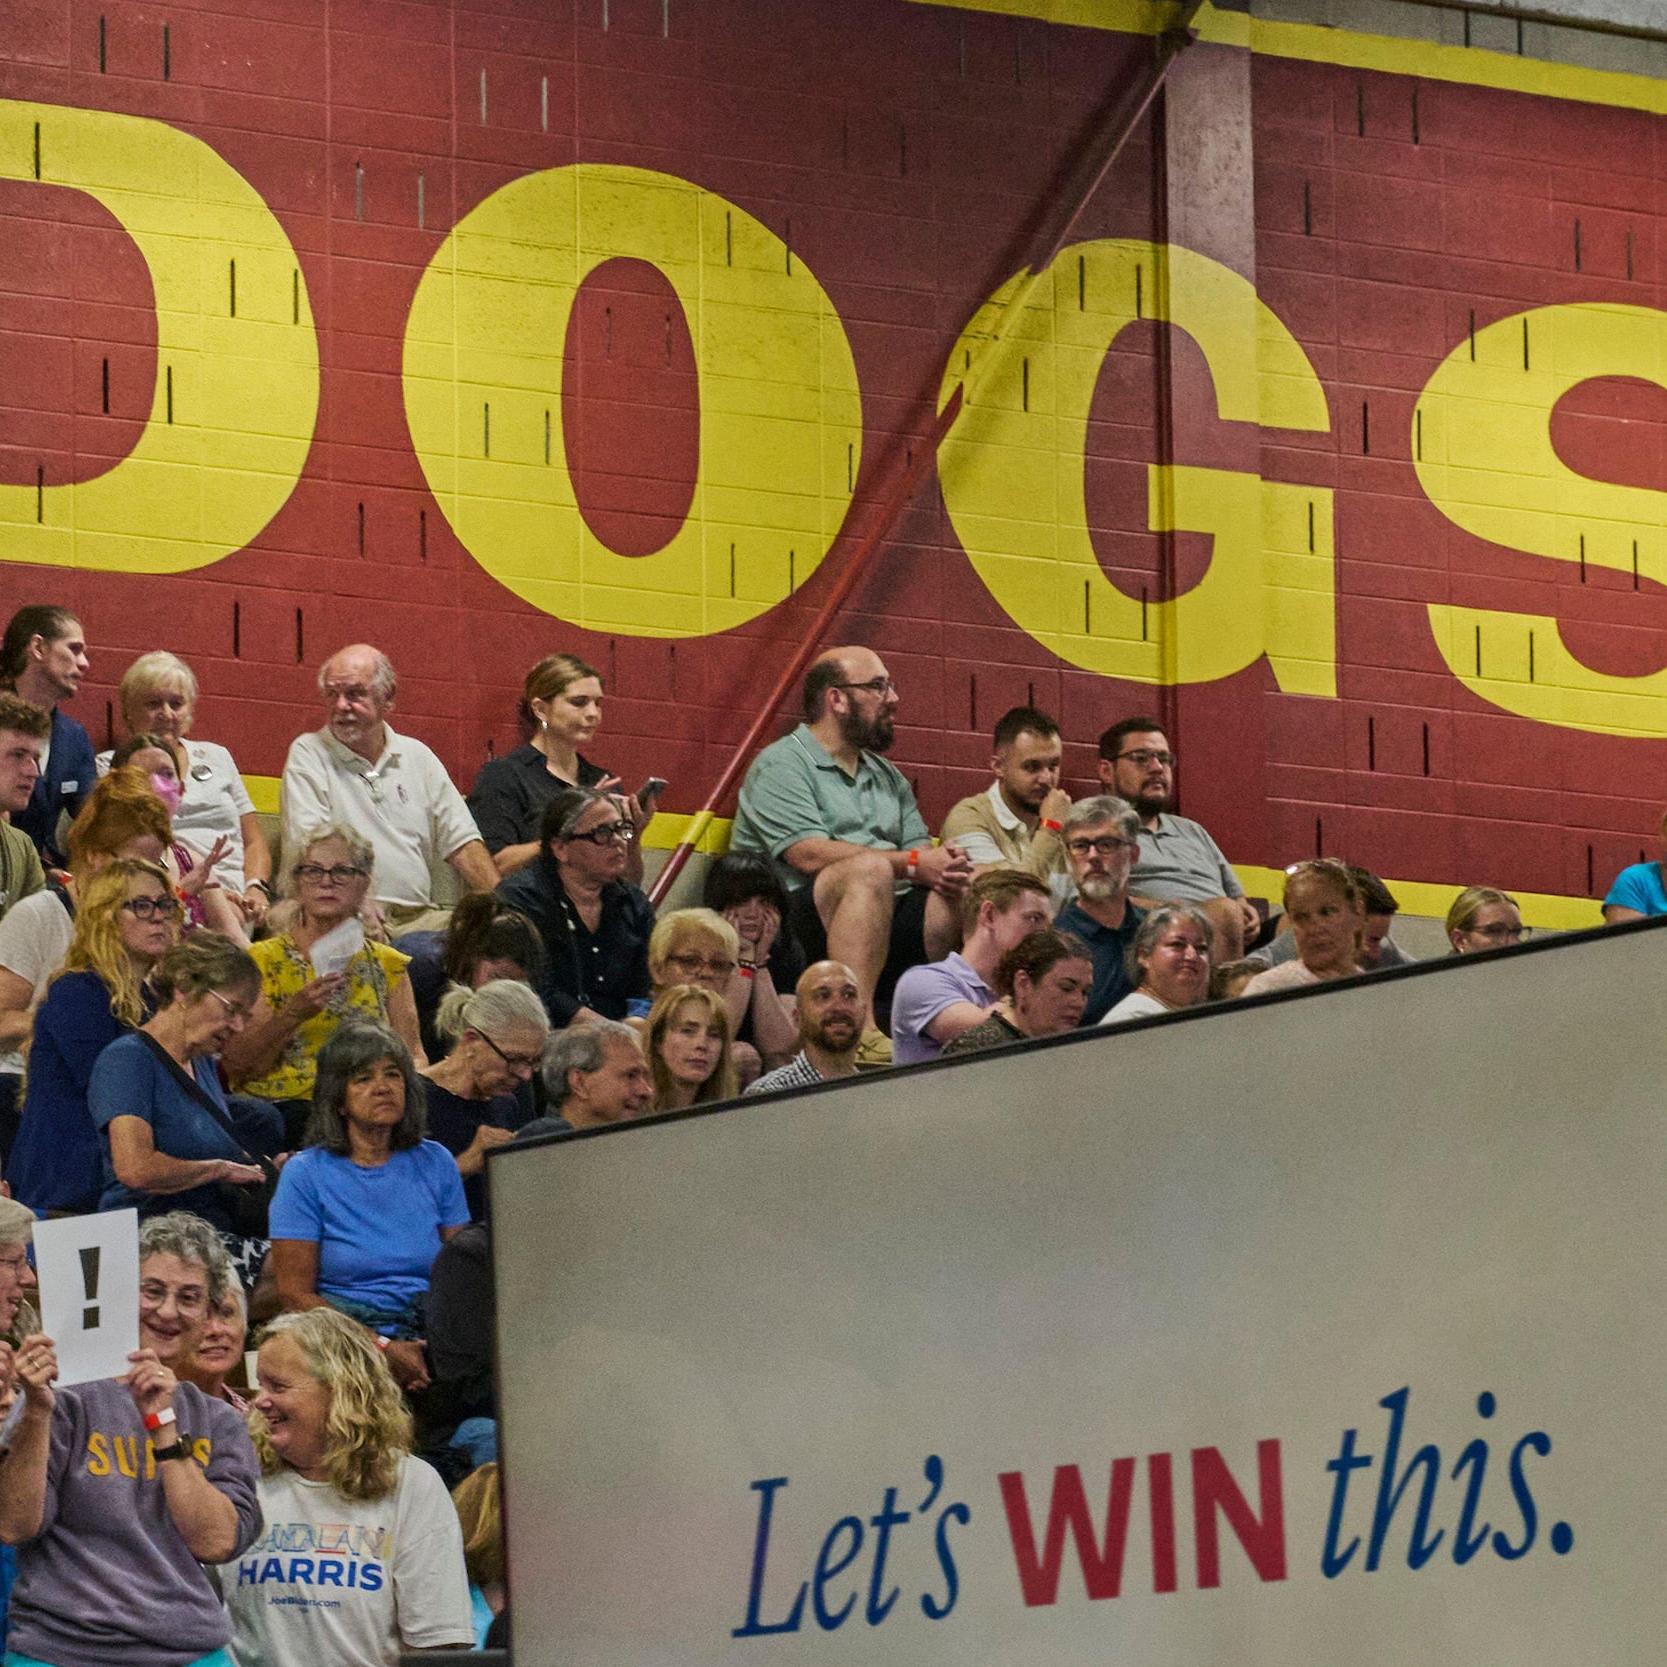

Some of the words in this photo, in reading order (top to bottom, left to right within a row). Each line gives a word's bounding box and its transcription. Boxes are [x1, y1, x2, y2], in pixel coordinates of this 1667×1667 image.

[238, 1558, 383, 1591] HARRIS
[731, 1454, 970, 1639] Let's
[998, 1438, 1289, 1608] WIN
[1320, 1386, 1575, 1579] this.
